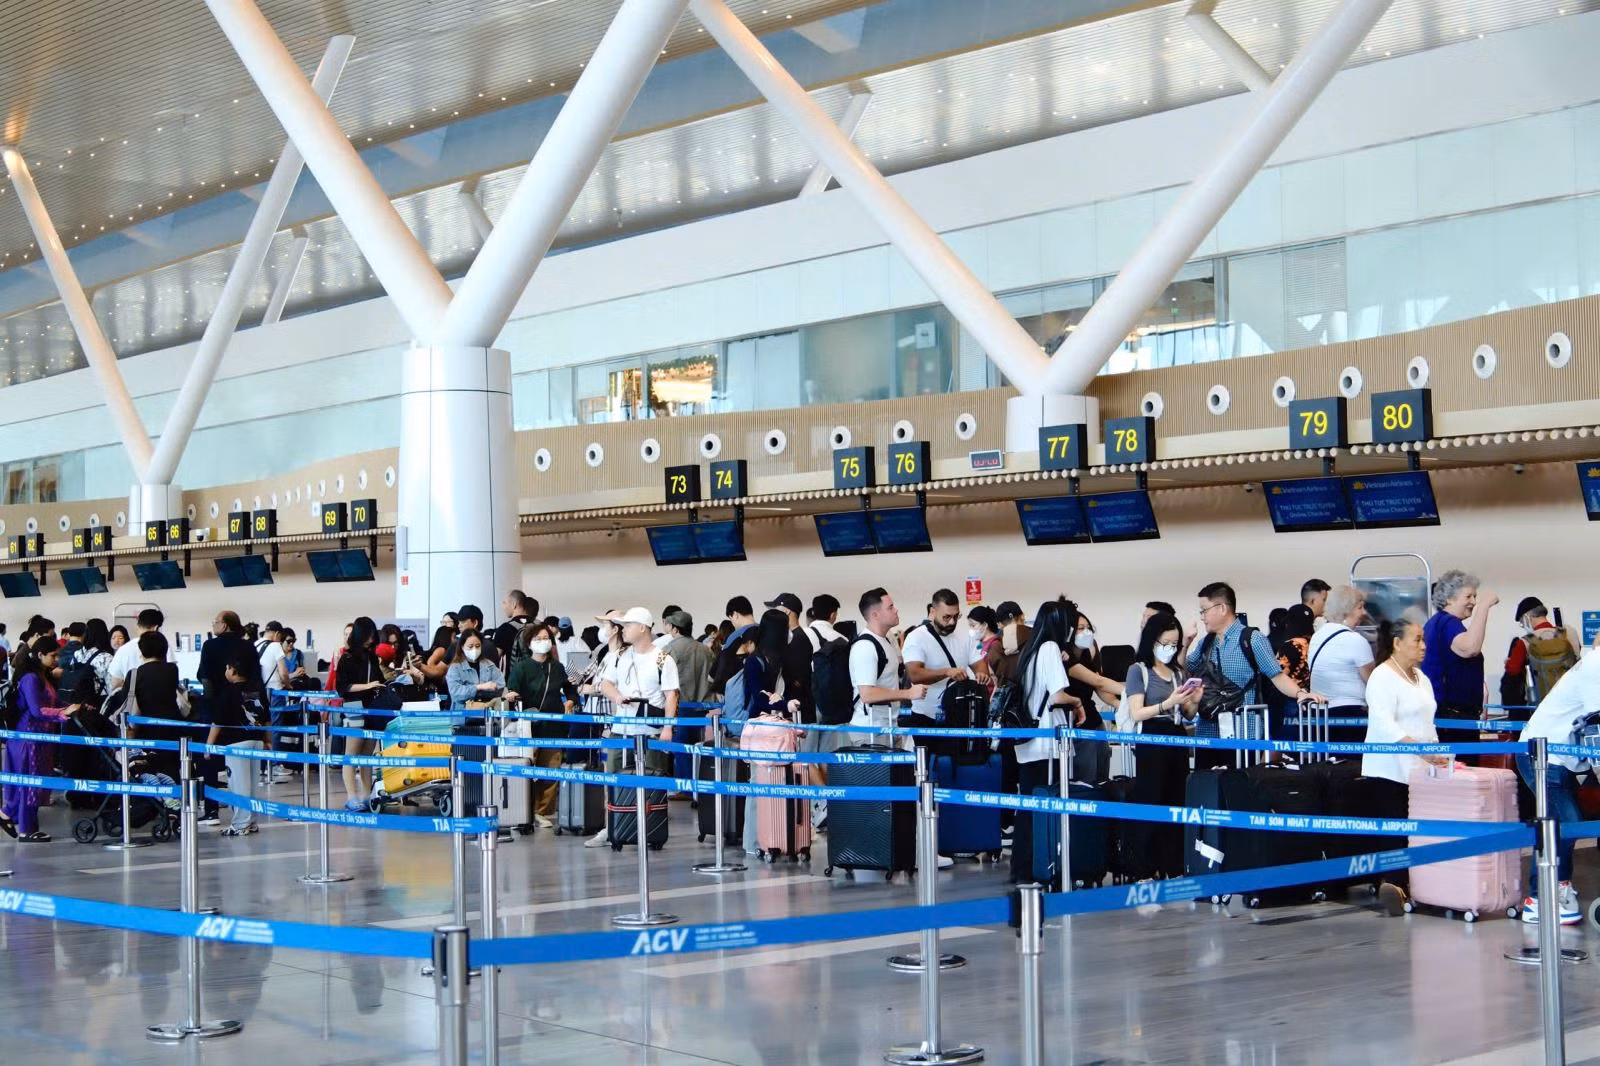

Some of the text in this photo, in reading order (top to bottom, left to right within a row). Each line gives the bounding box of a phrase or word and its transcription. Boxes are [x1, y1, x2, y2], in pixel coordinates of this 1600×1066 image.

[1299, 410, 1329, 436] 79
[1383, 404, 1413, 431] 80
[1047, 436, 1070, 460] 77
[1113, 429, 1139, 453] 78
[841, 457, 860, 478] 75
[895, 453, 915, 474] 76
[670, 474, 687, 495] 73
[715, 470, 733, 490] 74
[325, 511, 337, 527] 69
[354, 507, 366, 523] 70
[230, 519, 241, 534] 67
[255, 515, 267, 531] 68
[94, 532, 103, 546] 64
[148, 527, 157, 541] 65
[169, 525, 180, 539] 66
[9, 541, 17, 554] 61
[74, 534, 83, 548] 63
[592, 715, 605, 723] TIA
[1476, 721, 1491, 730] TIA
[1062, 729, 1076, 738] TIA
[494, 737, 505, 746] TIA
[684, 744, 701, 754] TIA
[1272, 741, 1291, 751] TIA
[1354, 744, 1370, 752] NHAT
[318, 753, 331, 764] TIA
[835, 753, 855, 764] TIA
[481, 763, 495, 774] TIA
[74, 779, 88, 791] TIA
[675, 779, 693, 791] TIA
[726, 784, 738, 792] TAN
[739, 785, 752, 793] SON
[753, 786, 769, 794] NHAT
[770, 786, 817, 796] INTERNATIONAL
[818, 788, 846, 797] AIRPORT
[250, 799, 264, 814] TIA
[432, 818, 451, 831] TIA
[1169, 807, 1202, 824] TIA
[1249, 815, 1266, 825] TAN
[1268, 816, 1284, 827] SON
[1287, 817, 1310, 828] NHAT
[1312, 818, 1379, 831] INTERNATIONAL
[1381, 821, 1419, 832] AIRPORT
[1348, 853, 1377, 875] ACV
[1125, 882, 1160, 906] ACV
[196, 917, 235, 938] ACV
[631, 928, 689, 954] ACV
